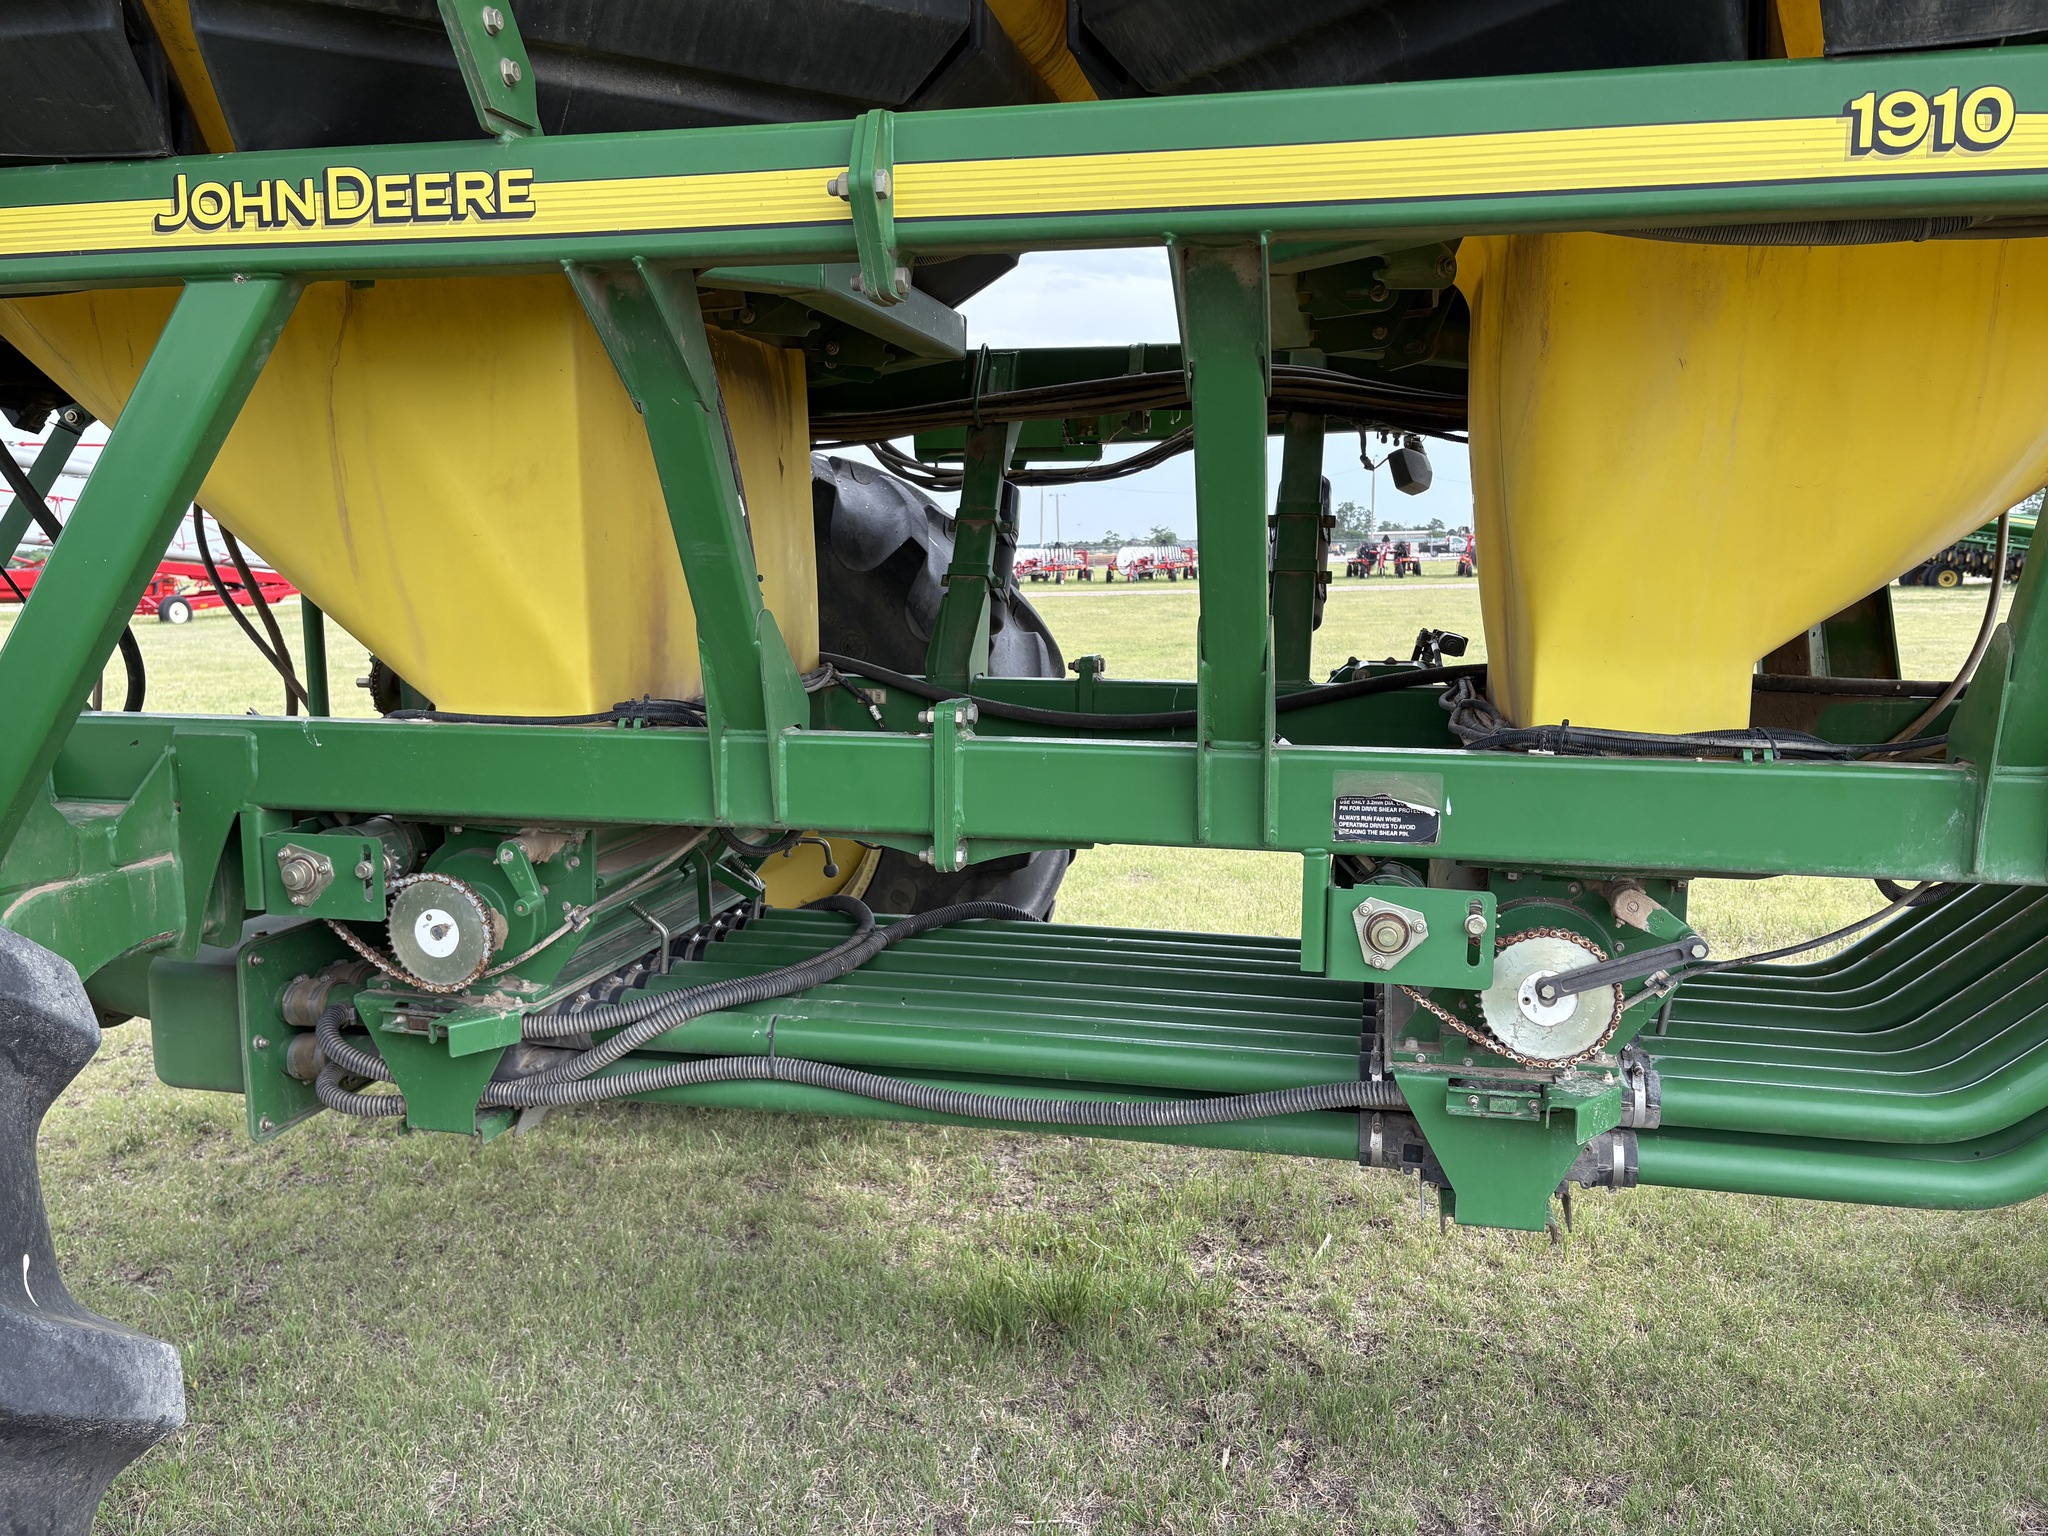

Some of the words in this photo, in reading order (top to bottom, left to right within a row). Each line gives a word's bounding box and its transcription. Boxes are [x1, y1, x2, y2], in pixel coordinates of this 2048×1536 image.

[1843, 84, 2016, 156] 1910
[153, 173, 316, 232] JOHN
[322, 166, 536, 225] DEERE
